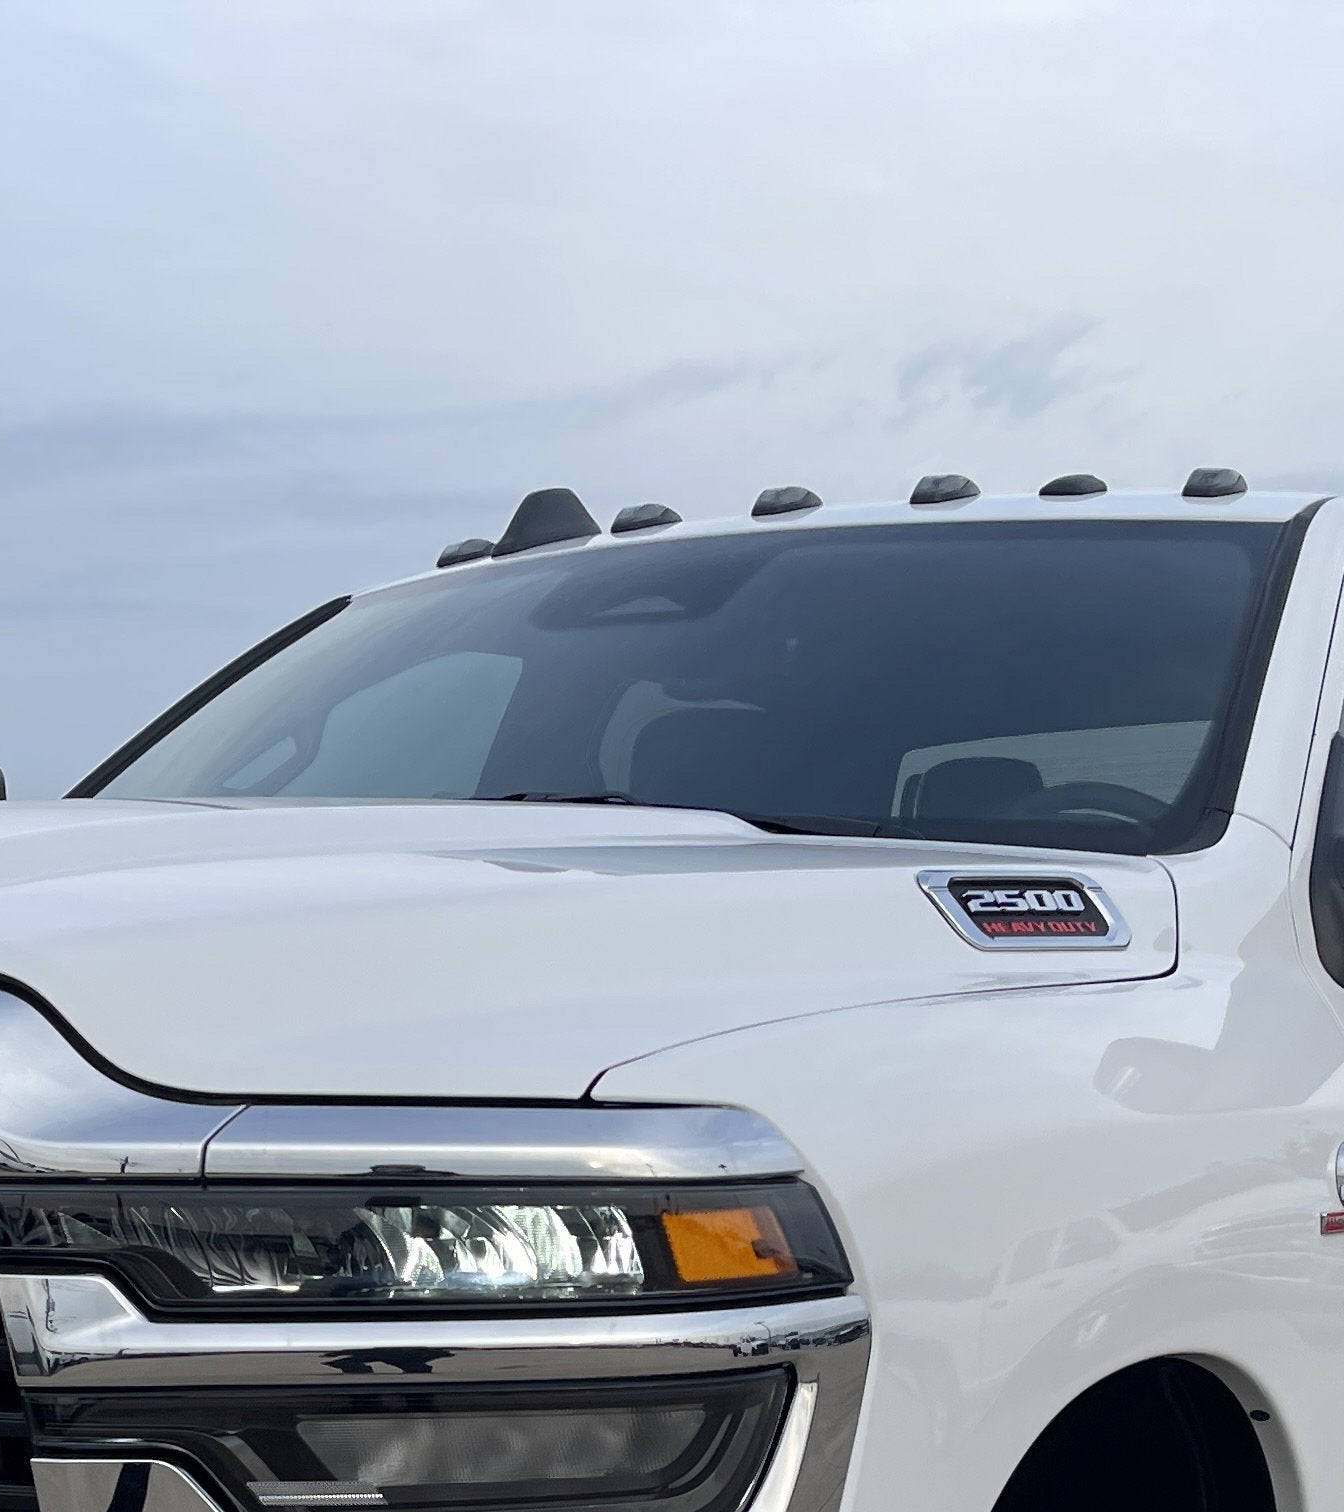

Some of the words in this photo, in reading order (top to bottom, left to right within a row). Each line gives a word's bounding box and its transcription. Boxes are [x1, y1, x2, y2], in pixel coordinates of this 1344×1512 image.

[962, 889, 1086, 913] 2500
[981, 921, 1047, 934] HEAVY
[1047, 920, 1098, 934] DUTY
